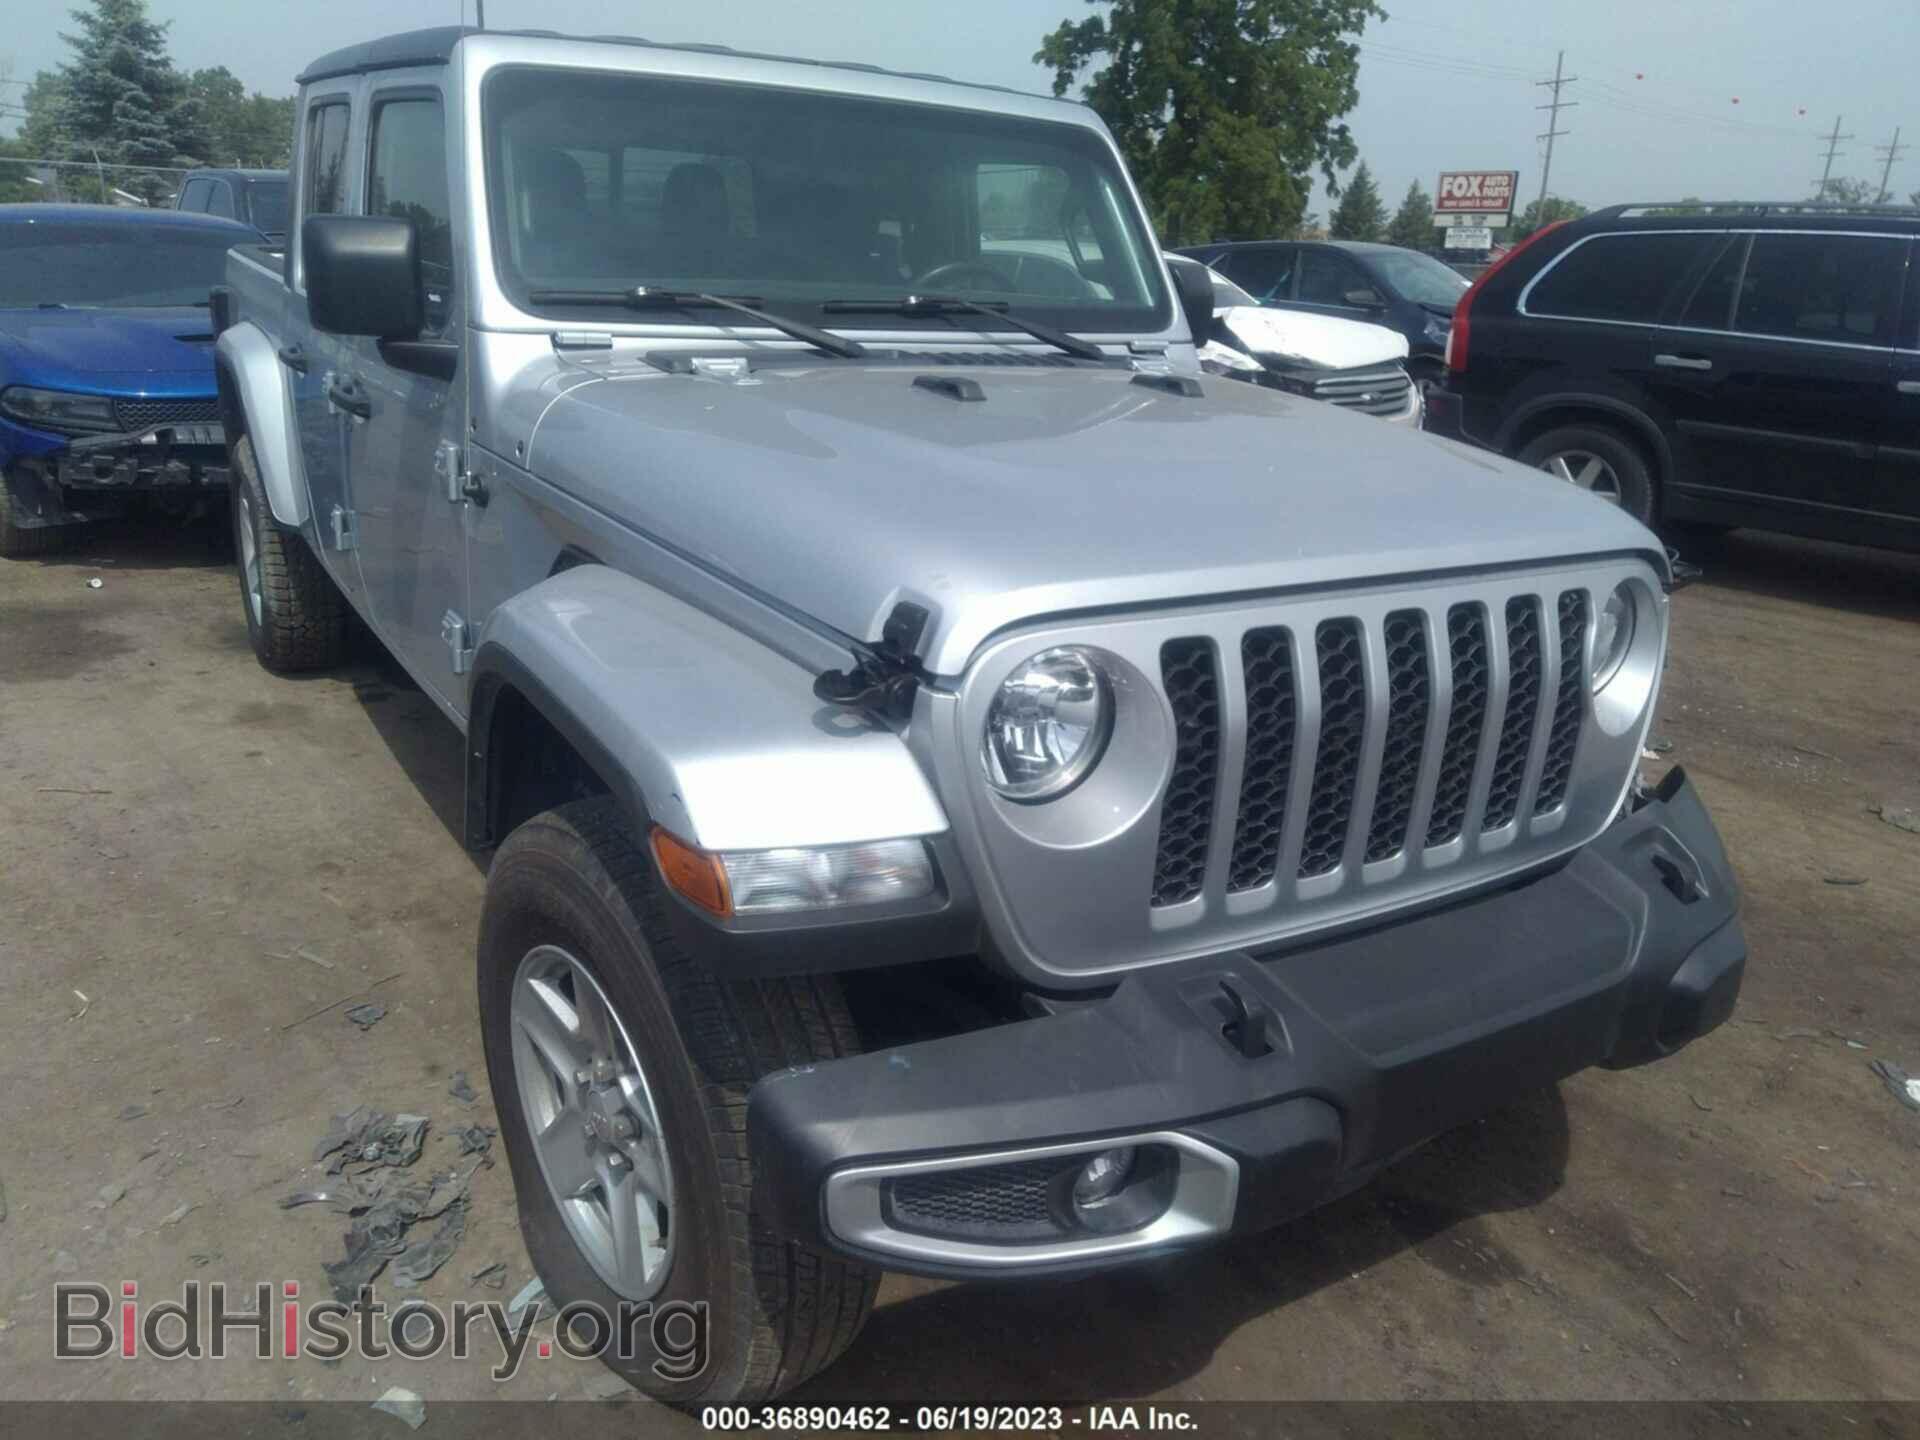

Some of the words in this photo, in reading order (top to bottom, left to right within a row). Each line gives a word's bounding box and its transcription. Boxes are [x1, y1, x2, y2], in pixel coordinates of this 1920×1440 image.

[1484, 176, 1509, 186] AUTO
[1441, 176, 1482, 198] FOX
[1482, 187, 1509, 198] PARTS
